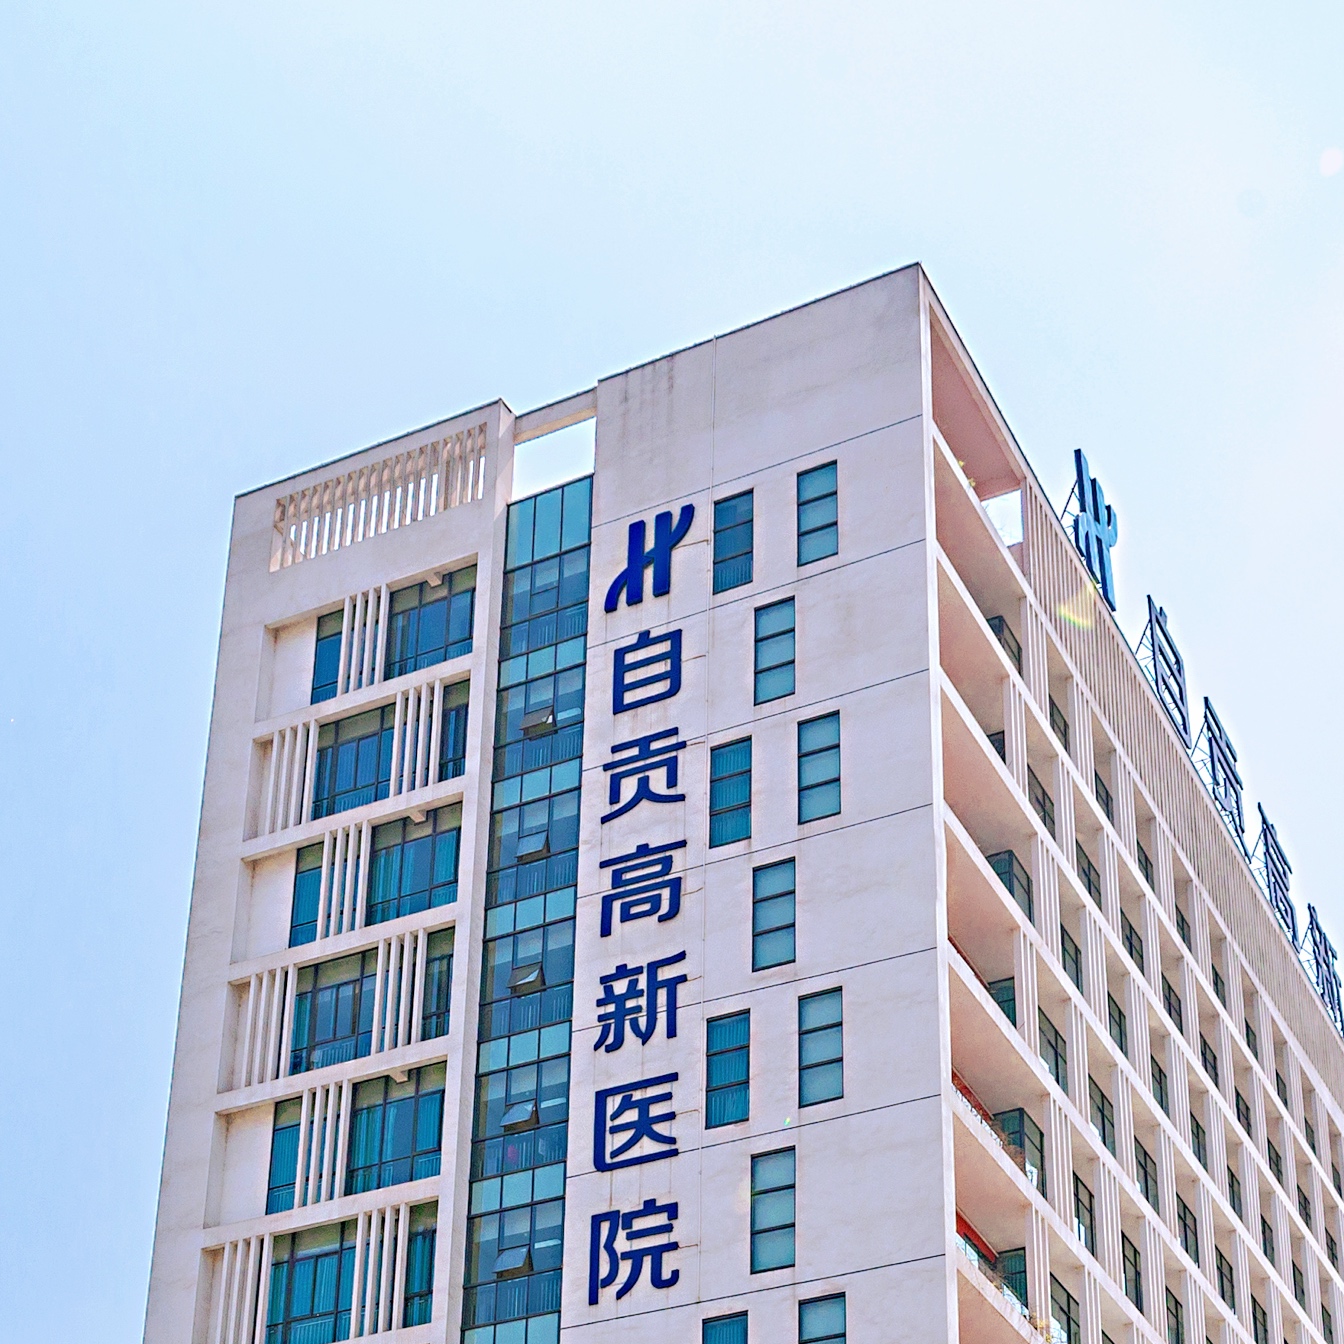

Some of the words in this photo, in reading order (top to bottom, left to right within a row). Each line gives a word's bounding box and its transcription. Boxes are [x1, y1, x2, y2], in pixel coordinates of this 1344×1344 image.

[589, 629, 688, 1305] 自贡高新医院
